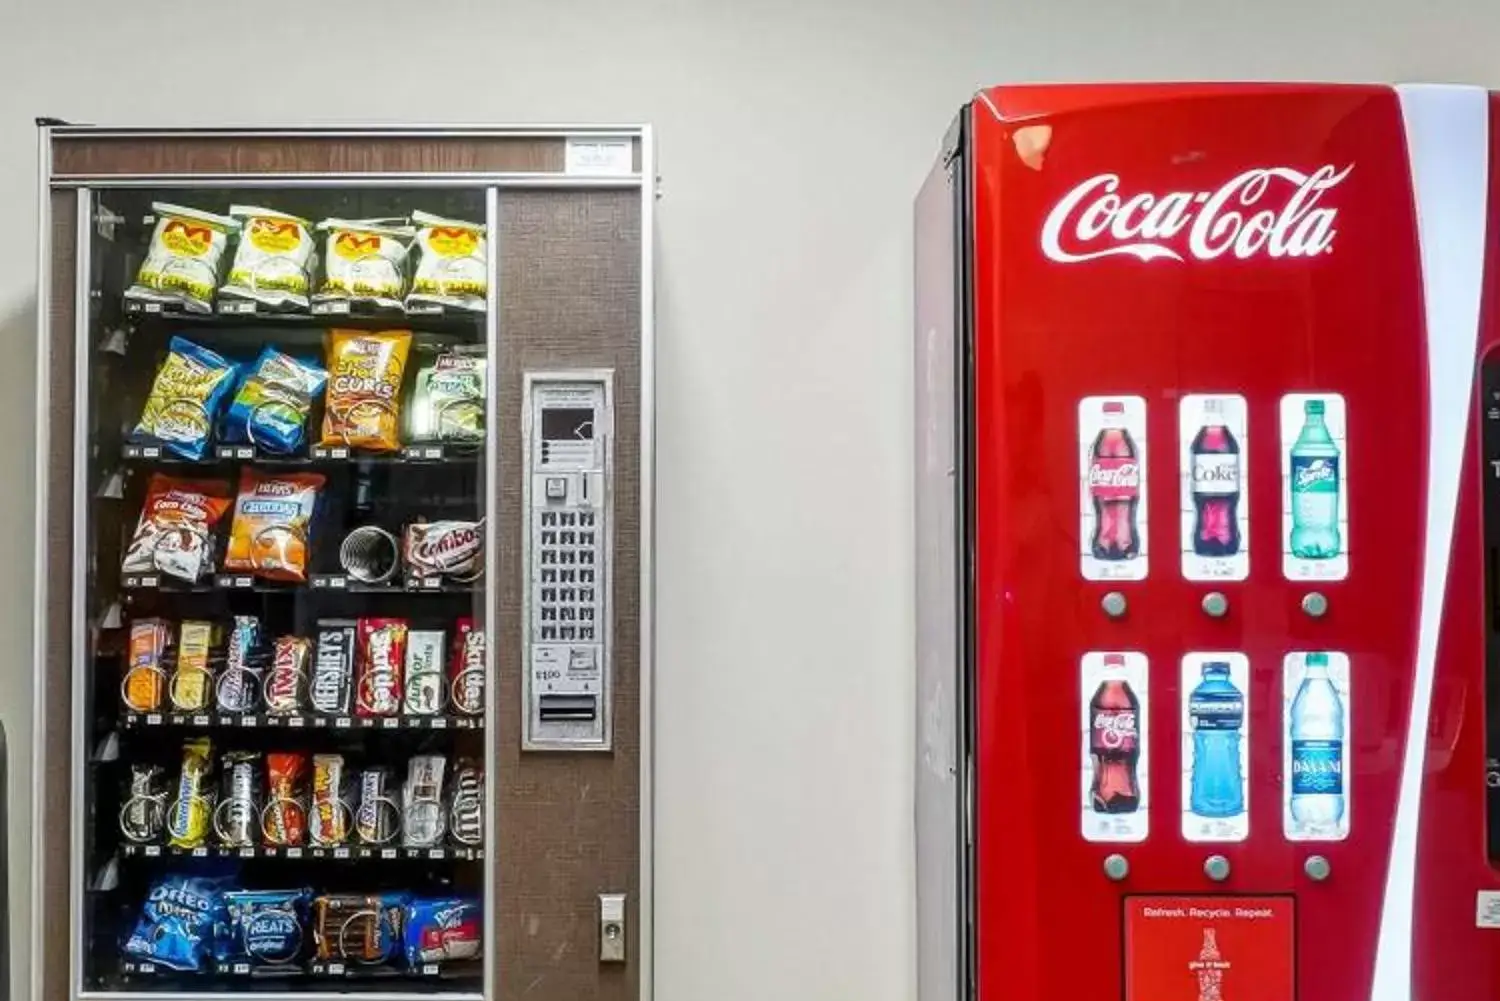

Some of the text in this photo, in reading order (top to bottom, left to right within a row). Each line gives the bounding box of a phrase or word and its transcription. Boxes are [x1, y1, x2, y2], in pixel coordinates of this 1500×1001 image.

[1041, 161, 1356, 263] Coca-Cola
[334, 377, 394, 399] CURLS
[1192, 464, 1237, 483] Coke
[315, 631, 344, 713] HERSHEY'S
[1143, 907, 1186, 918] Refresh.
